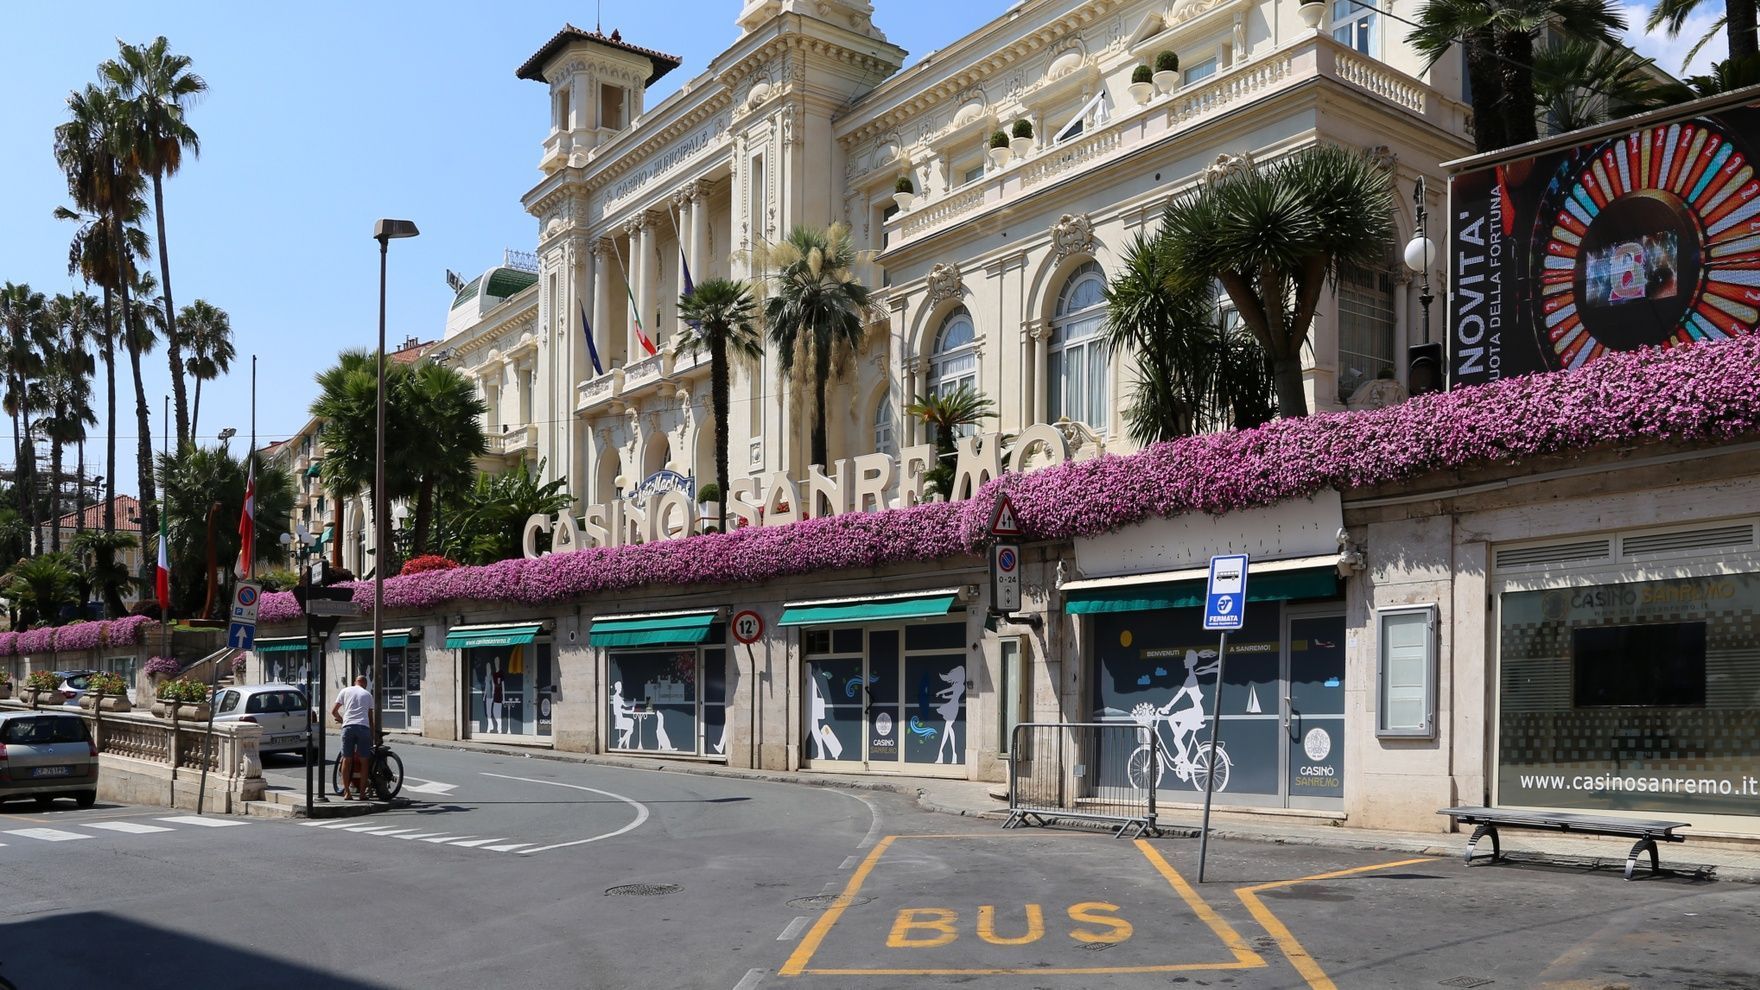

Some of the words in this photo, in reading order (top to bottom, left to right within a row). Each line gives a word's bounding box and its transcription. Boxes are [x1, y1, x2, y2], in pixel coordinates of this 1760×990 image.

[652, 130, 709, 179] MUNICIPALE
[1490, 184, 1502, 268] FORTUNA
[1458, 211, 1485, 375] NOVITA'
[1490, 275, 1501, 328] DELLA
[523, 490, 695, 560] CASINO
[728, 422, 1069, 532] SANREMO
[1641, 583, 1735, 605] SANREMO
[1295, 776, 1339, 788] SANREMO
[1300, 765, 1335, 776] CASINÒ
[1520, 773, 1759, 795] www.casinosanremo.it
[886, 902, 1133, 948] BUS
